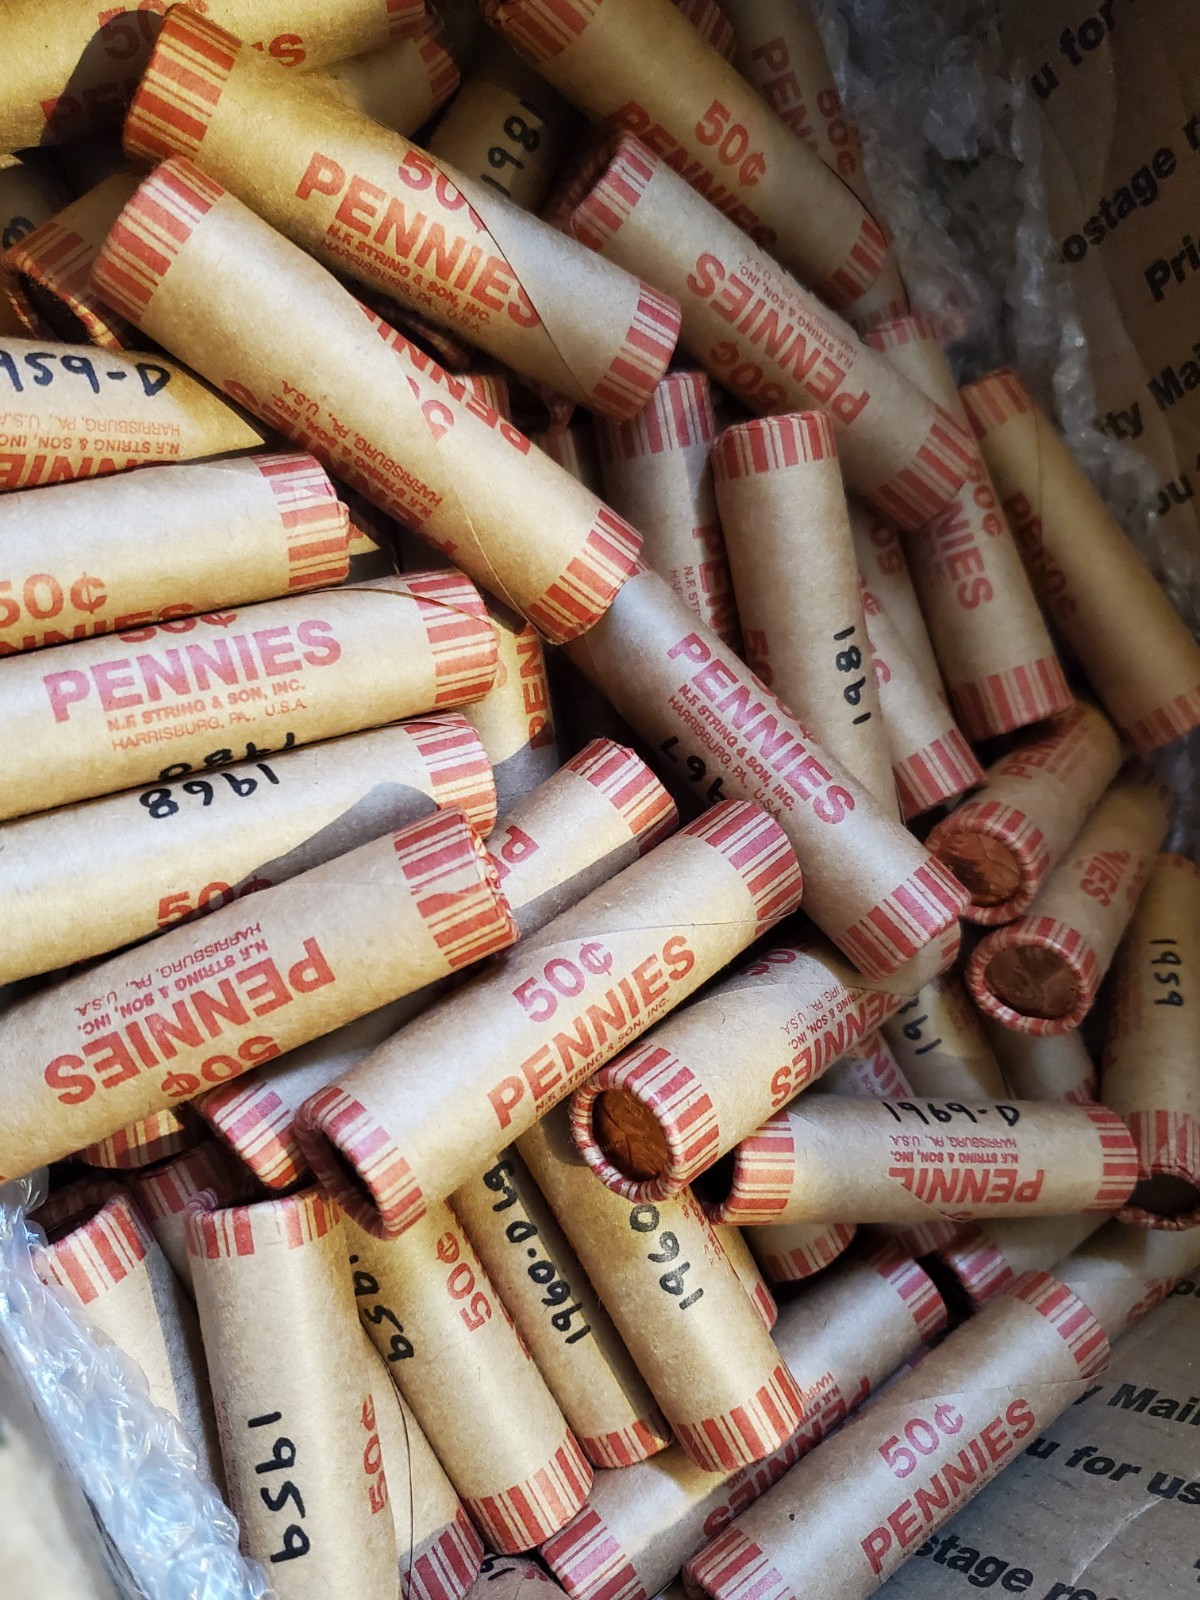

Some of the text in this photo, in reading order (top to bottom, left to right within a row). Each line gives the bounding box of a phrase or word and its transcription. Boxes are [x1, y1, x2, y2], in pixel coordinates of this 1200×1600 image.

[695, 98, 767, 188] 50¢
[295, 151, 541, 328] PENNIES
[1060, 147, 1178, 265] ostage
[356, 240, 411, 278] STRING
[412, 273, 424, 286] &
[1145, 233, 1200, 302] Pri
[687, 253, 871, 426] PENNIES
[796, 316, 835, 353] STRING
[79, 438, 89, 451] &
[94, 438, 153, 454] STRING
[1093, 402, 1144, 440] ty
[353, 432, 443, 507] HARRISBURG,
[353, 455, 407, 498] STRING
[43, 619, 342, 724] PENNIES
[111, 716, 225, 752] HARRISBURG,
[141, 699, 206, 725] STRING
[212, 695, 224, 709] &
[666, 631, 857, 827] PENNIES
[668, 696, 732, 770] HARRISBURG,
[697, 704, 738, 749] STRING
[736, 746, 748, 760] &
[156, 922, 262, 979] HARRISBURG,
[174, 954, 237, 993] STRING
[511, 941, 614, 1024] 50¢
[44, 936, 337, 1106] PENNIES
[486, 935, 696, 1130] PENNIES
[958, 1152, 998, 1164] STRING
[348, 1254, 416, 1364] 959
[436, 1230, 493, 1332] 50¢
[359, 1393, 389, 1515] 50¢
[878, 1401, 965, 1480] 50¢
[1064, 1445, 1142, 1482] for
[247, 1411, 312, 1563] 1959
[860, 1398, 1037, 1576] PENNIES
